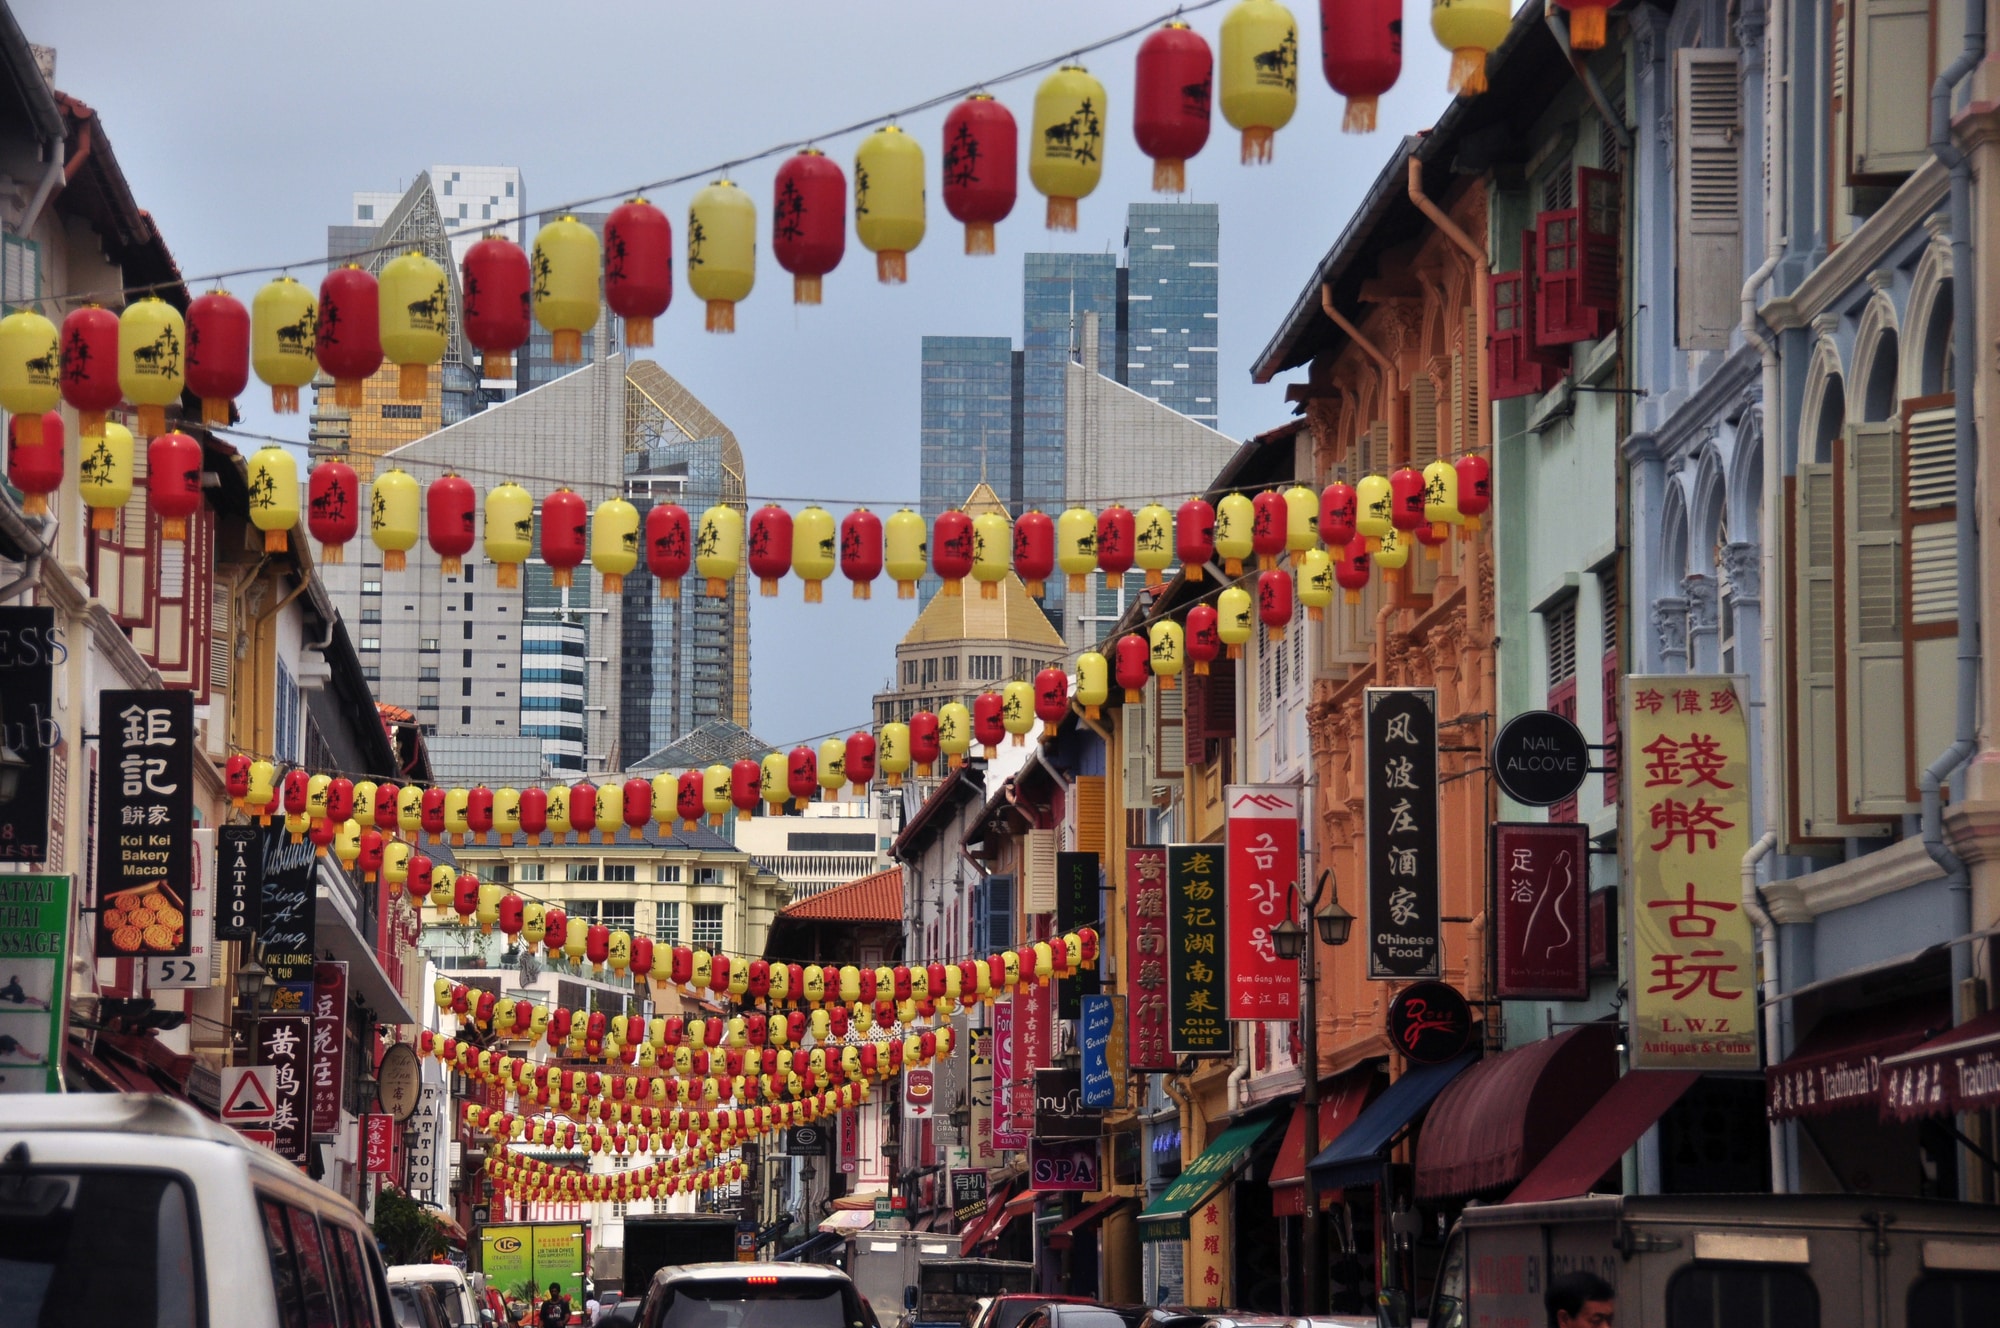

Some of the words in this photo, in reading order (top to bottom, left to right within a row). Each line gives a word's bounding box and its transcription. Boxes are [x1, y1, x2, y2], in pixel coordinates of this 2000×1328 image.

[1523, 737, 1560, 750] NAIL
[1506, 757, 1577, 771] ALCOVE
[1385, 712, 1419, 924] 风波庄酒家
[120, 836, 143, 846] Koi
[149, 835, 171, 846] Kei
[122, 850, 169, 863] Bakery
[123, 865, 168, 875] Macao
[1510, 849, 1534, 902] 足浴
[232, 841, 247, 927] TATTOO
[1182, 852, 1217, 1012] 老杨记湖南菜
[1378, 934, 1434, 945] Chinese
[1388, 946, 1423, 957] Food
[283, 953, 312, 965] LOUNGE
[160, 961, 197, 981] 52
[277, 967, 292, 978] PUB
[1255, 975, 1272, 984] Gang
[1662, 1018, 1730, 1032] L.W.Z
[1643, 1042, 1696, 1054] Antiques
[1701, 1042, 1711, 1052] &
[1716, 1042, 1751, 1053] Coins
[1096, 1054, 1102, 1065] &
[1820, 1058, 1869, 1100] Traditional
[416, 1086, 433, 1182] TATTOO
[1035, 1159, 1094, 1183] SPA
[954, 1174, 984, 1190] 有机
[955, 1199, 987, 1217] ORGANIC
[1307, 1206, 1312, 1217] 5
